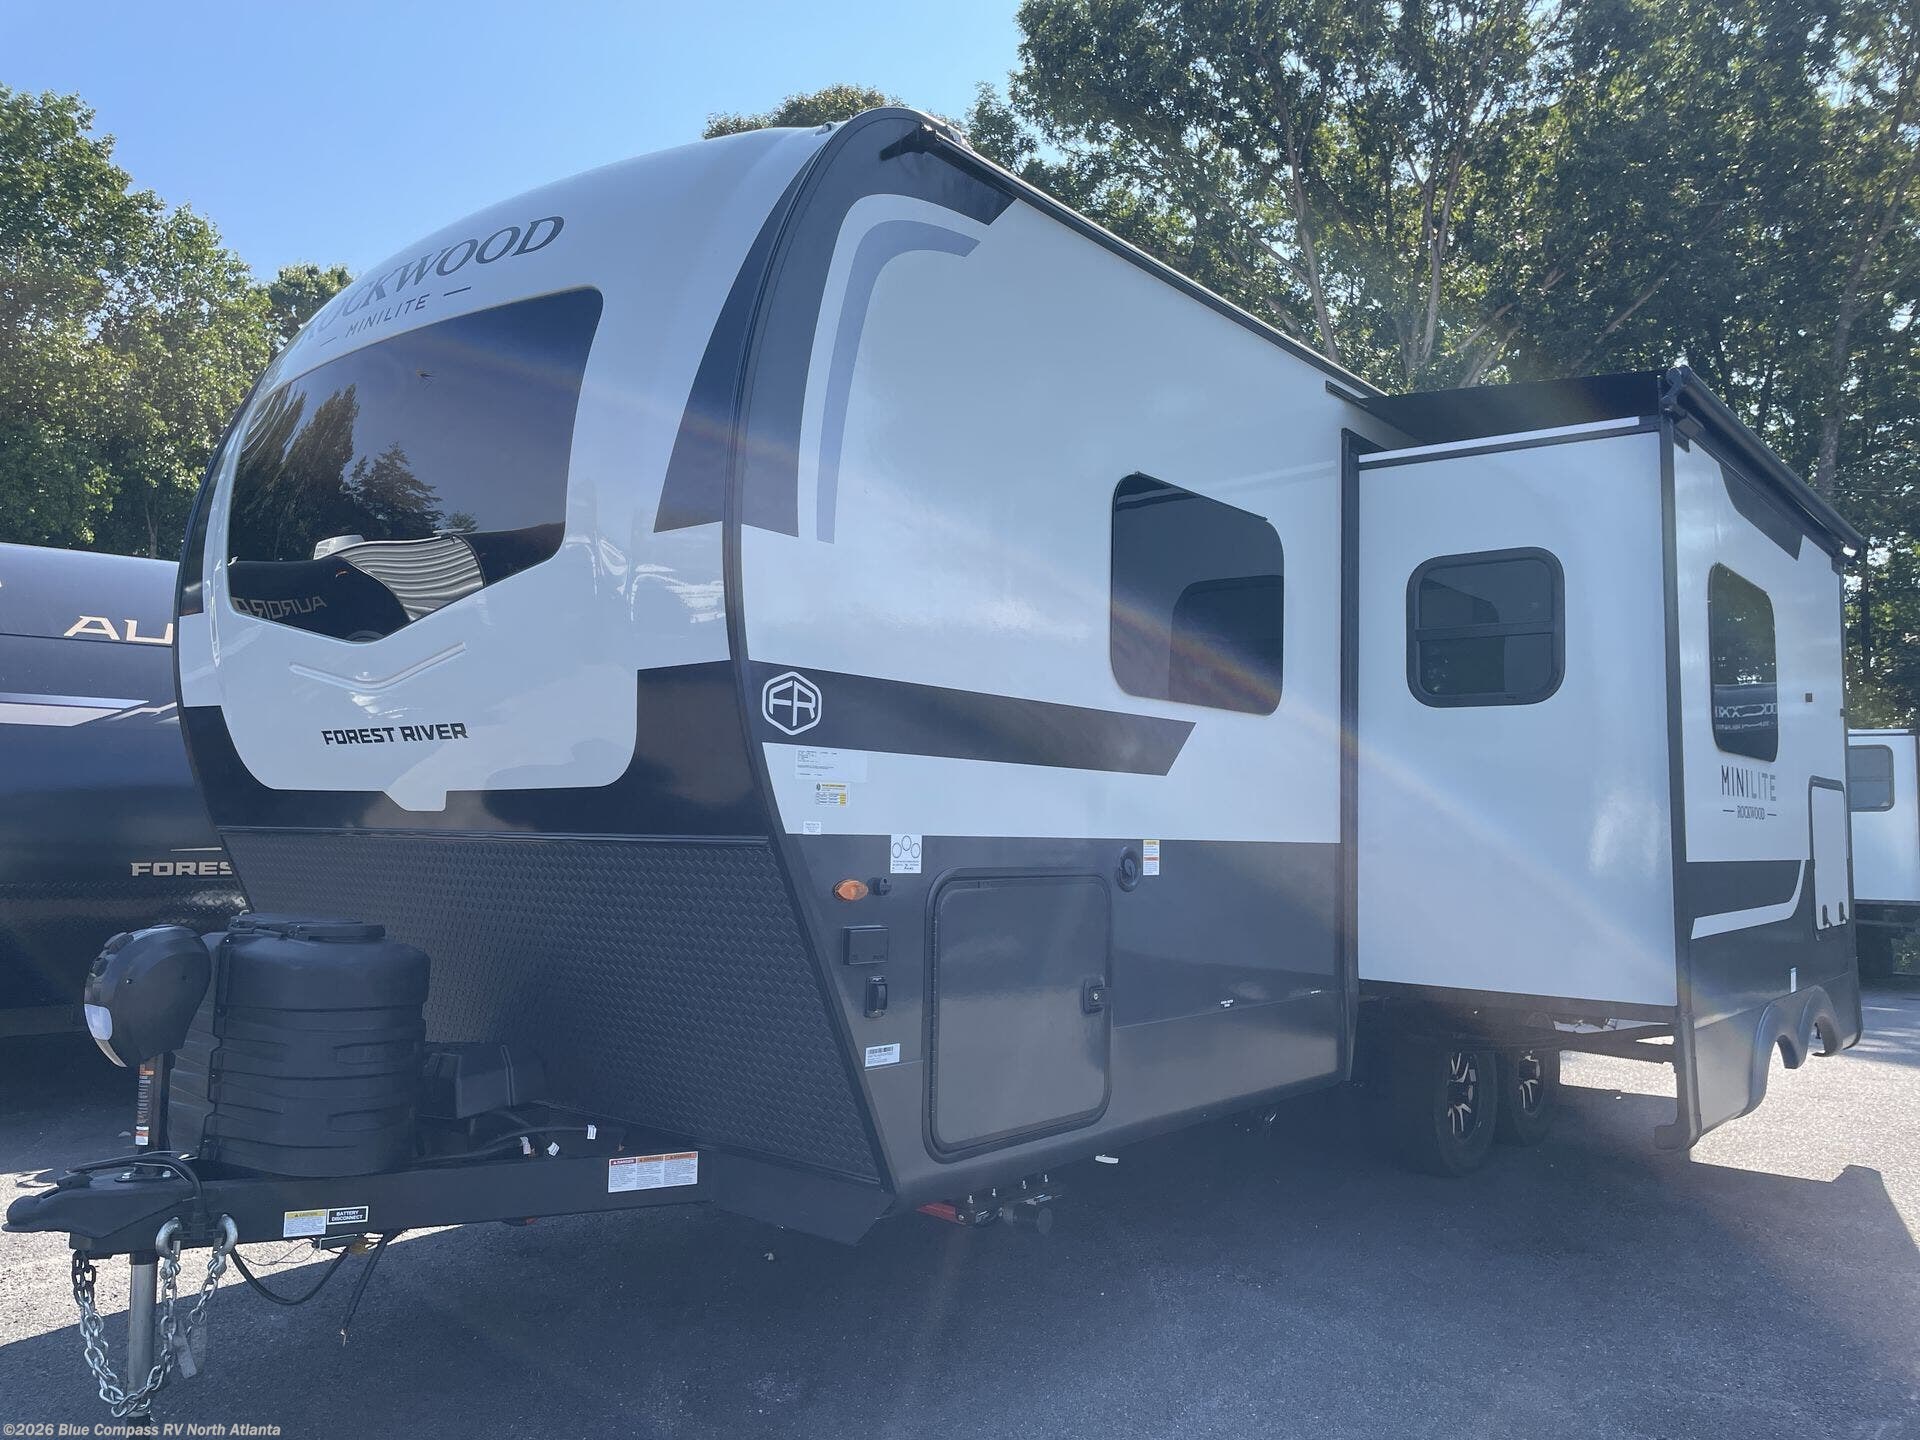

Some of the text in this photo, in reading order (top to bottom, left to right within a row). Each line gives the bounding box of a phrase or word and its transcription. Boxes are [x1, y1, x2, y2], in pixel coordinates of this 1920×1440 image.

[345, 293, 430, 338] MINILITE
[321, 722, 469, 745] FOREST RIVER
[1721, 764, 1777, 801] MINILITE
[1737, 805, 1765, 820] ROCKWOOD
[331, 1214, 363, 1222] DISCONNECT
